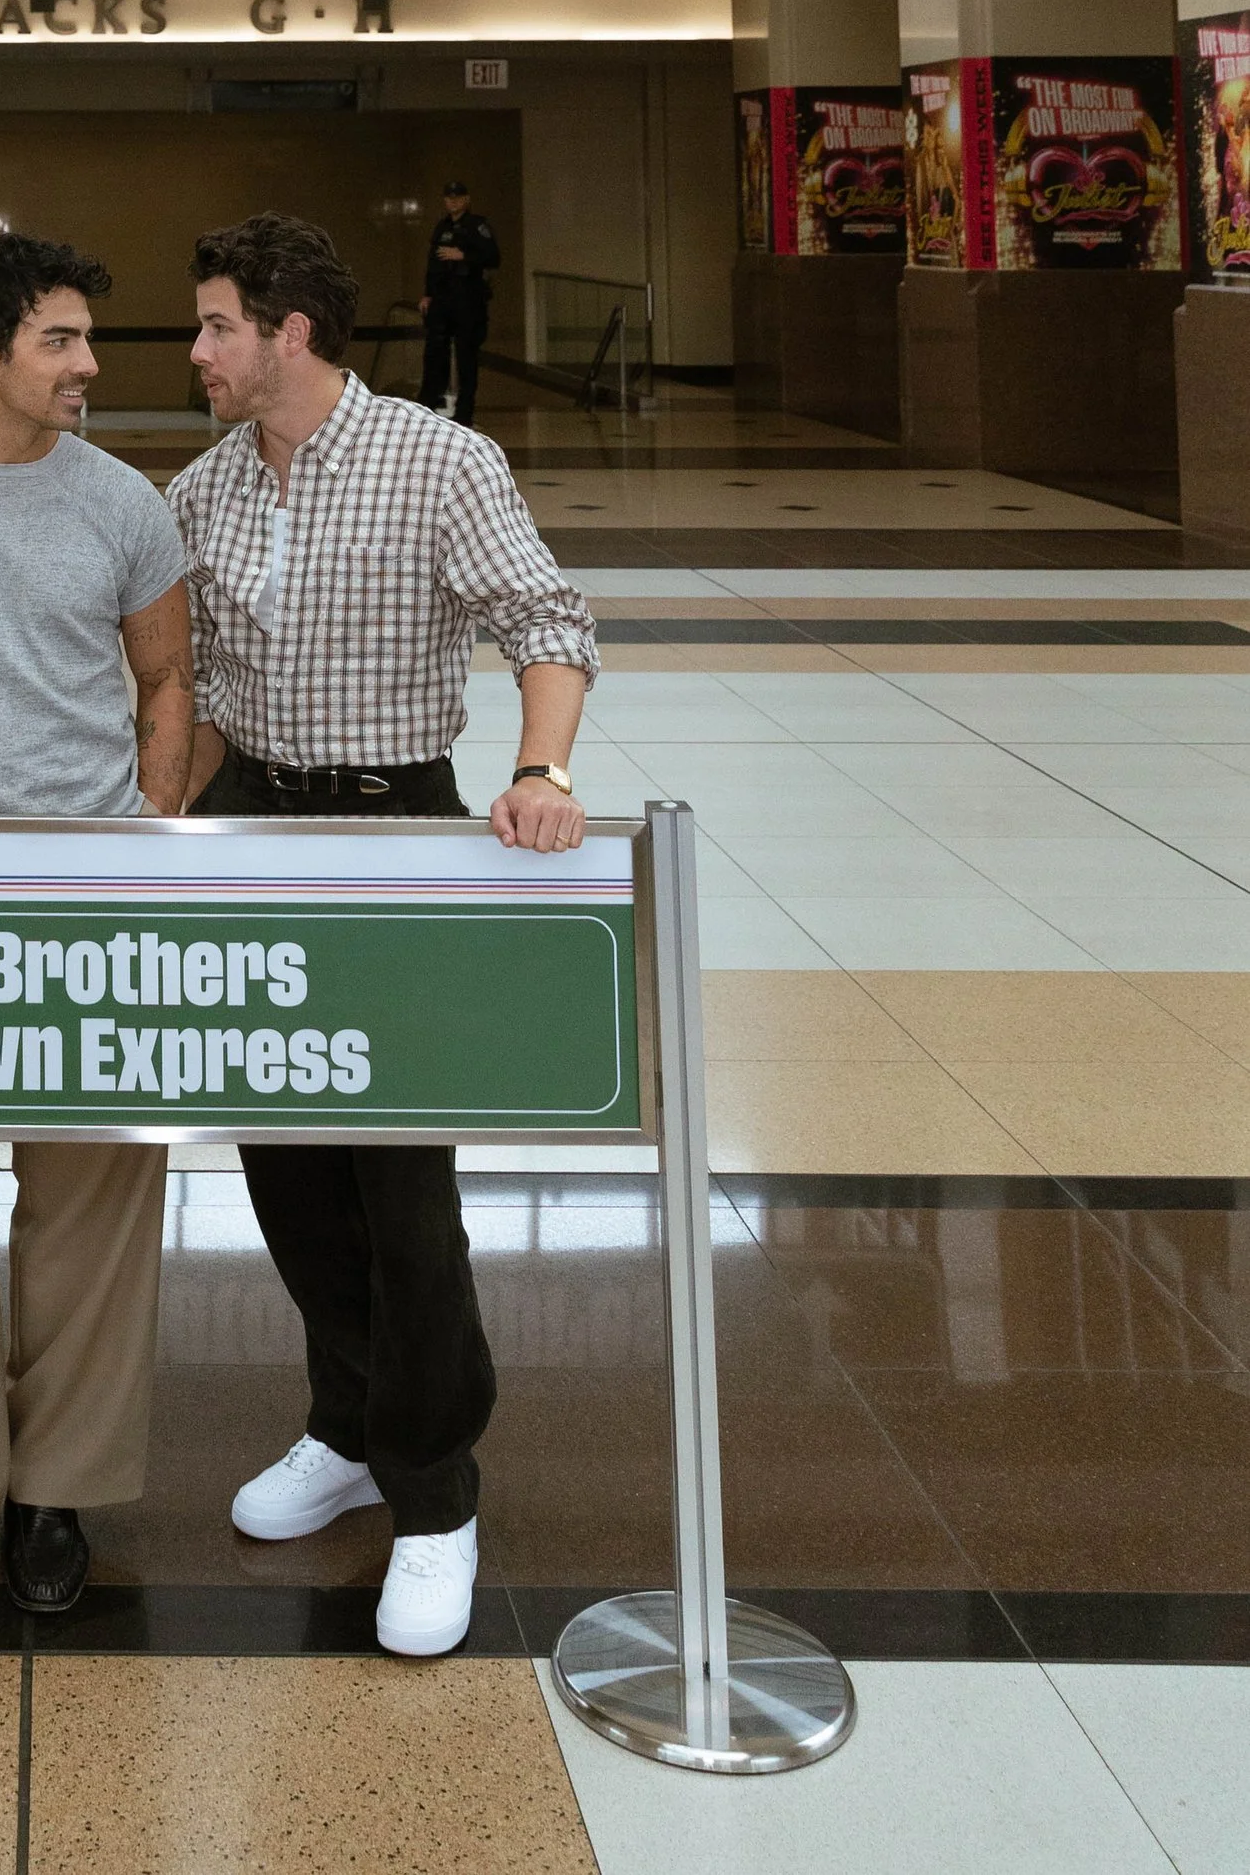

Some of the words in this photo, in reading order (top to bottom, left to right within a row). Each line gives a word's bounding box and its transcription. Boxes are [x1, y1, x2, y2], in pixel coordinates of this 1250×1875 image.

[472, 62, 500, 86] EXIT
[1029, 107, 1056, 137] ON
[80, 1017, 372, 1100] Express
